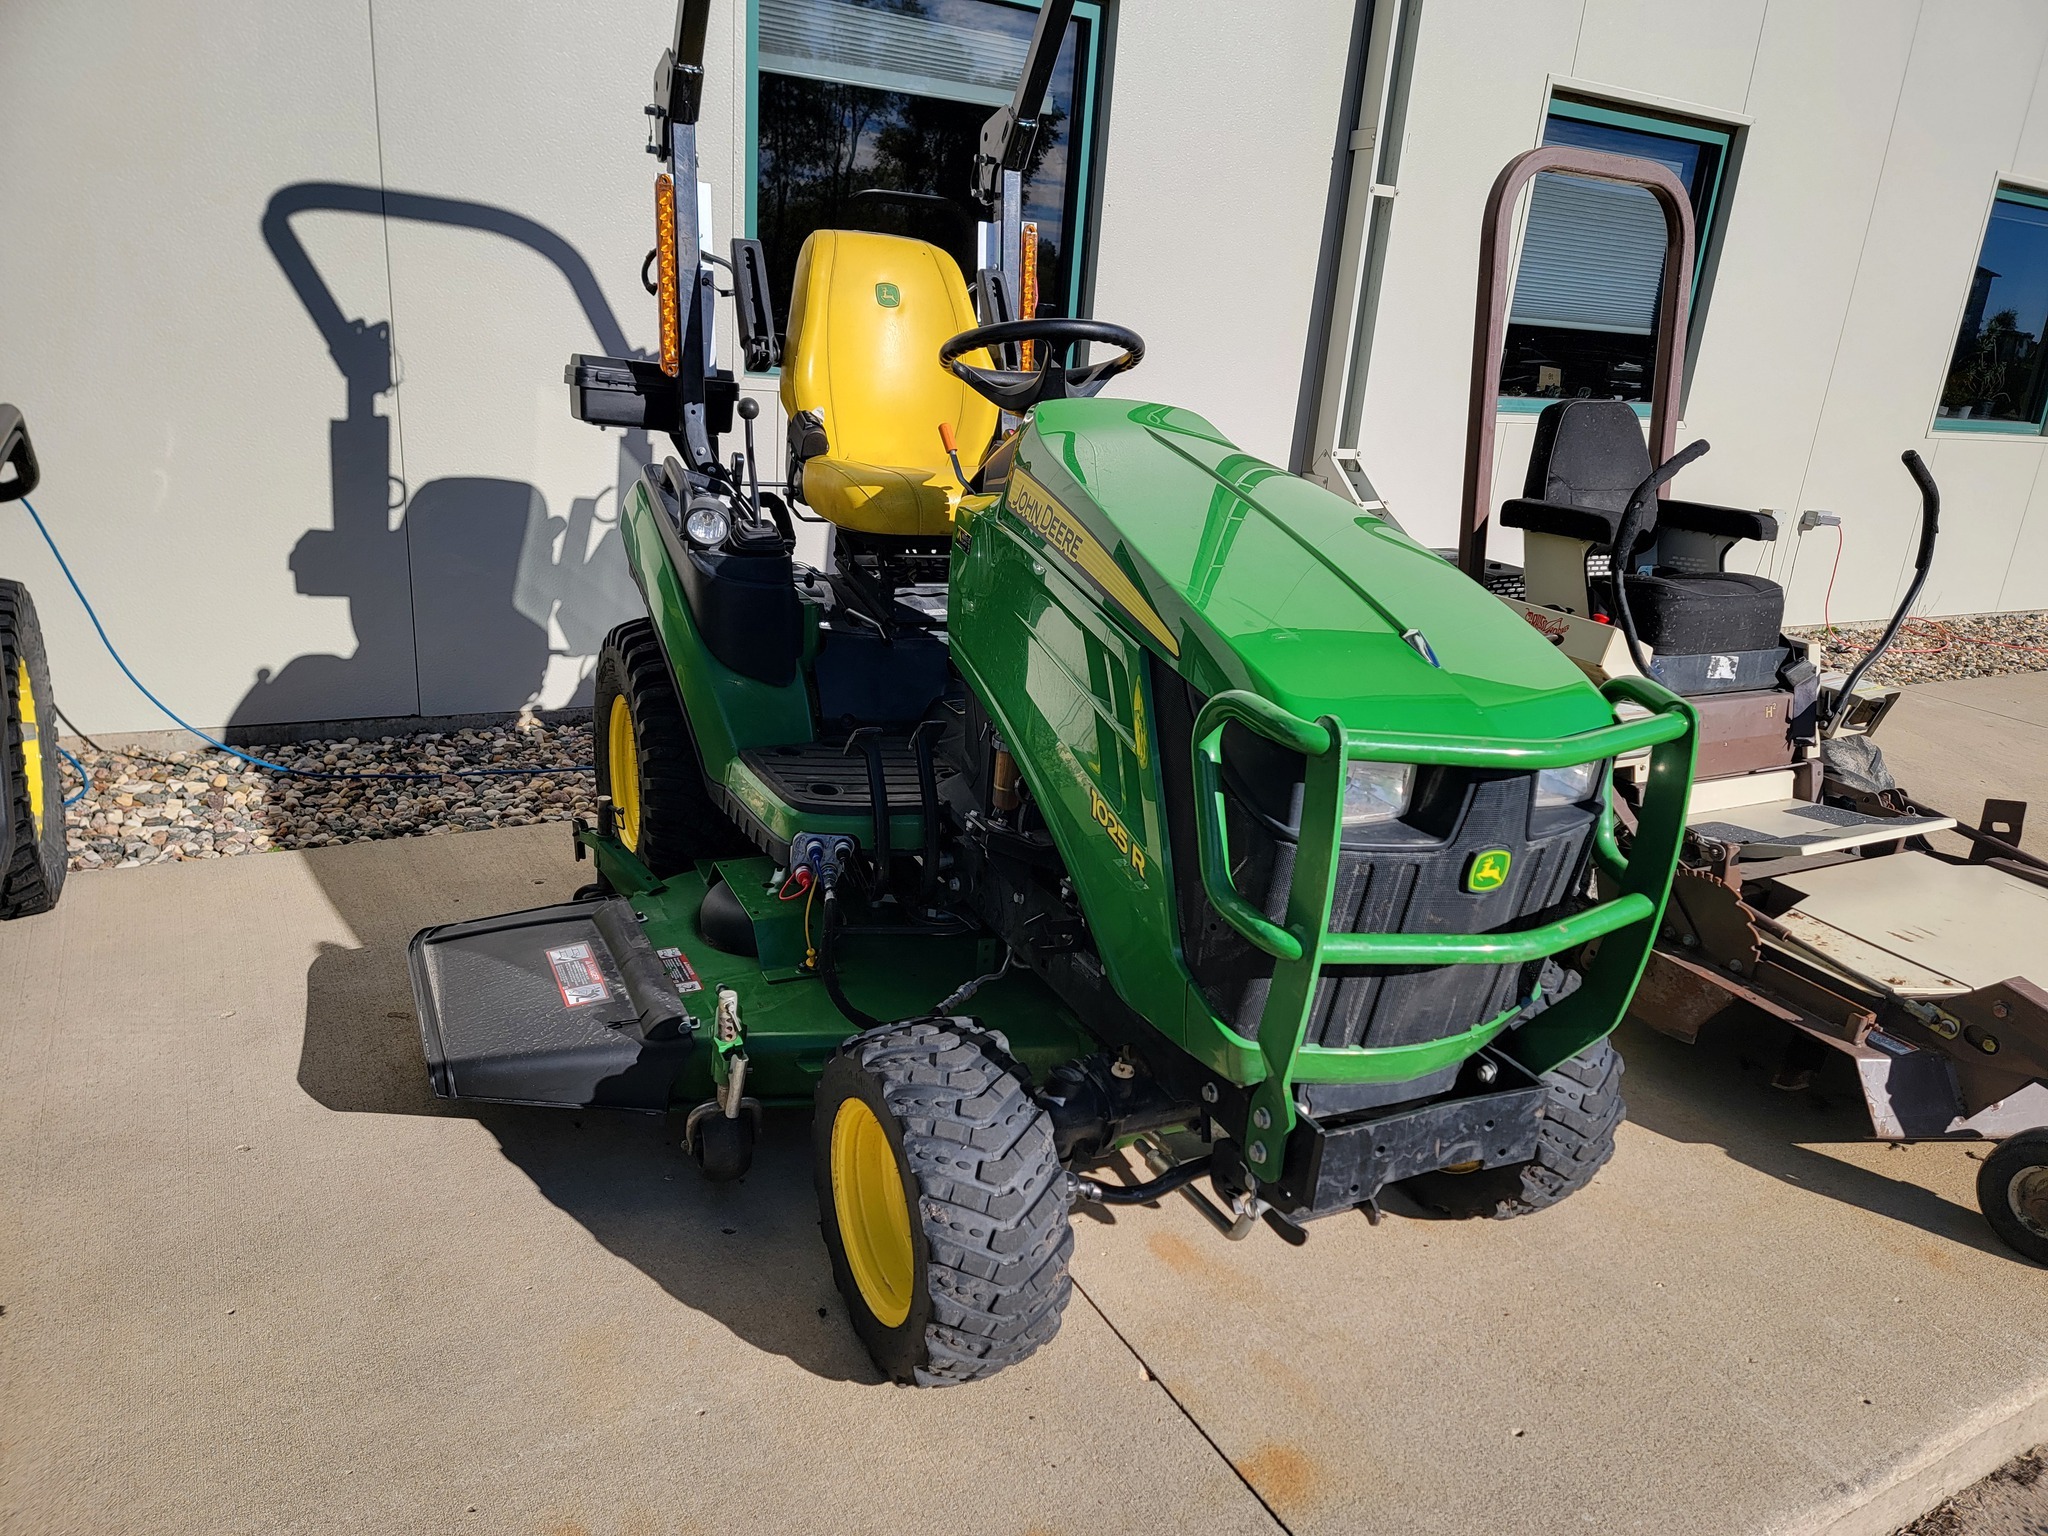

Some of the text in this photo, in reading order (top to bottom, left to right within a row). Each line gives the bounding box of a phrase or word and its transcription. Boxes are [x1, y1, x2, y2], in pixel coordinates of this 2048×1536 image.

[1013, 484, 1083, 559] JOHN DEERE
[1090, 787, 1145, 880] 1025 R
